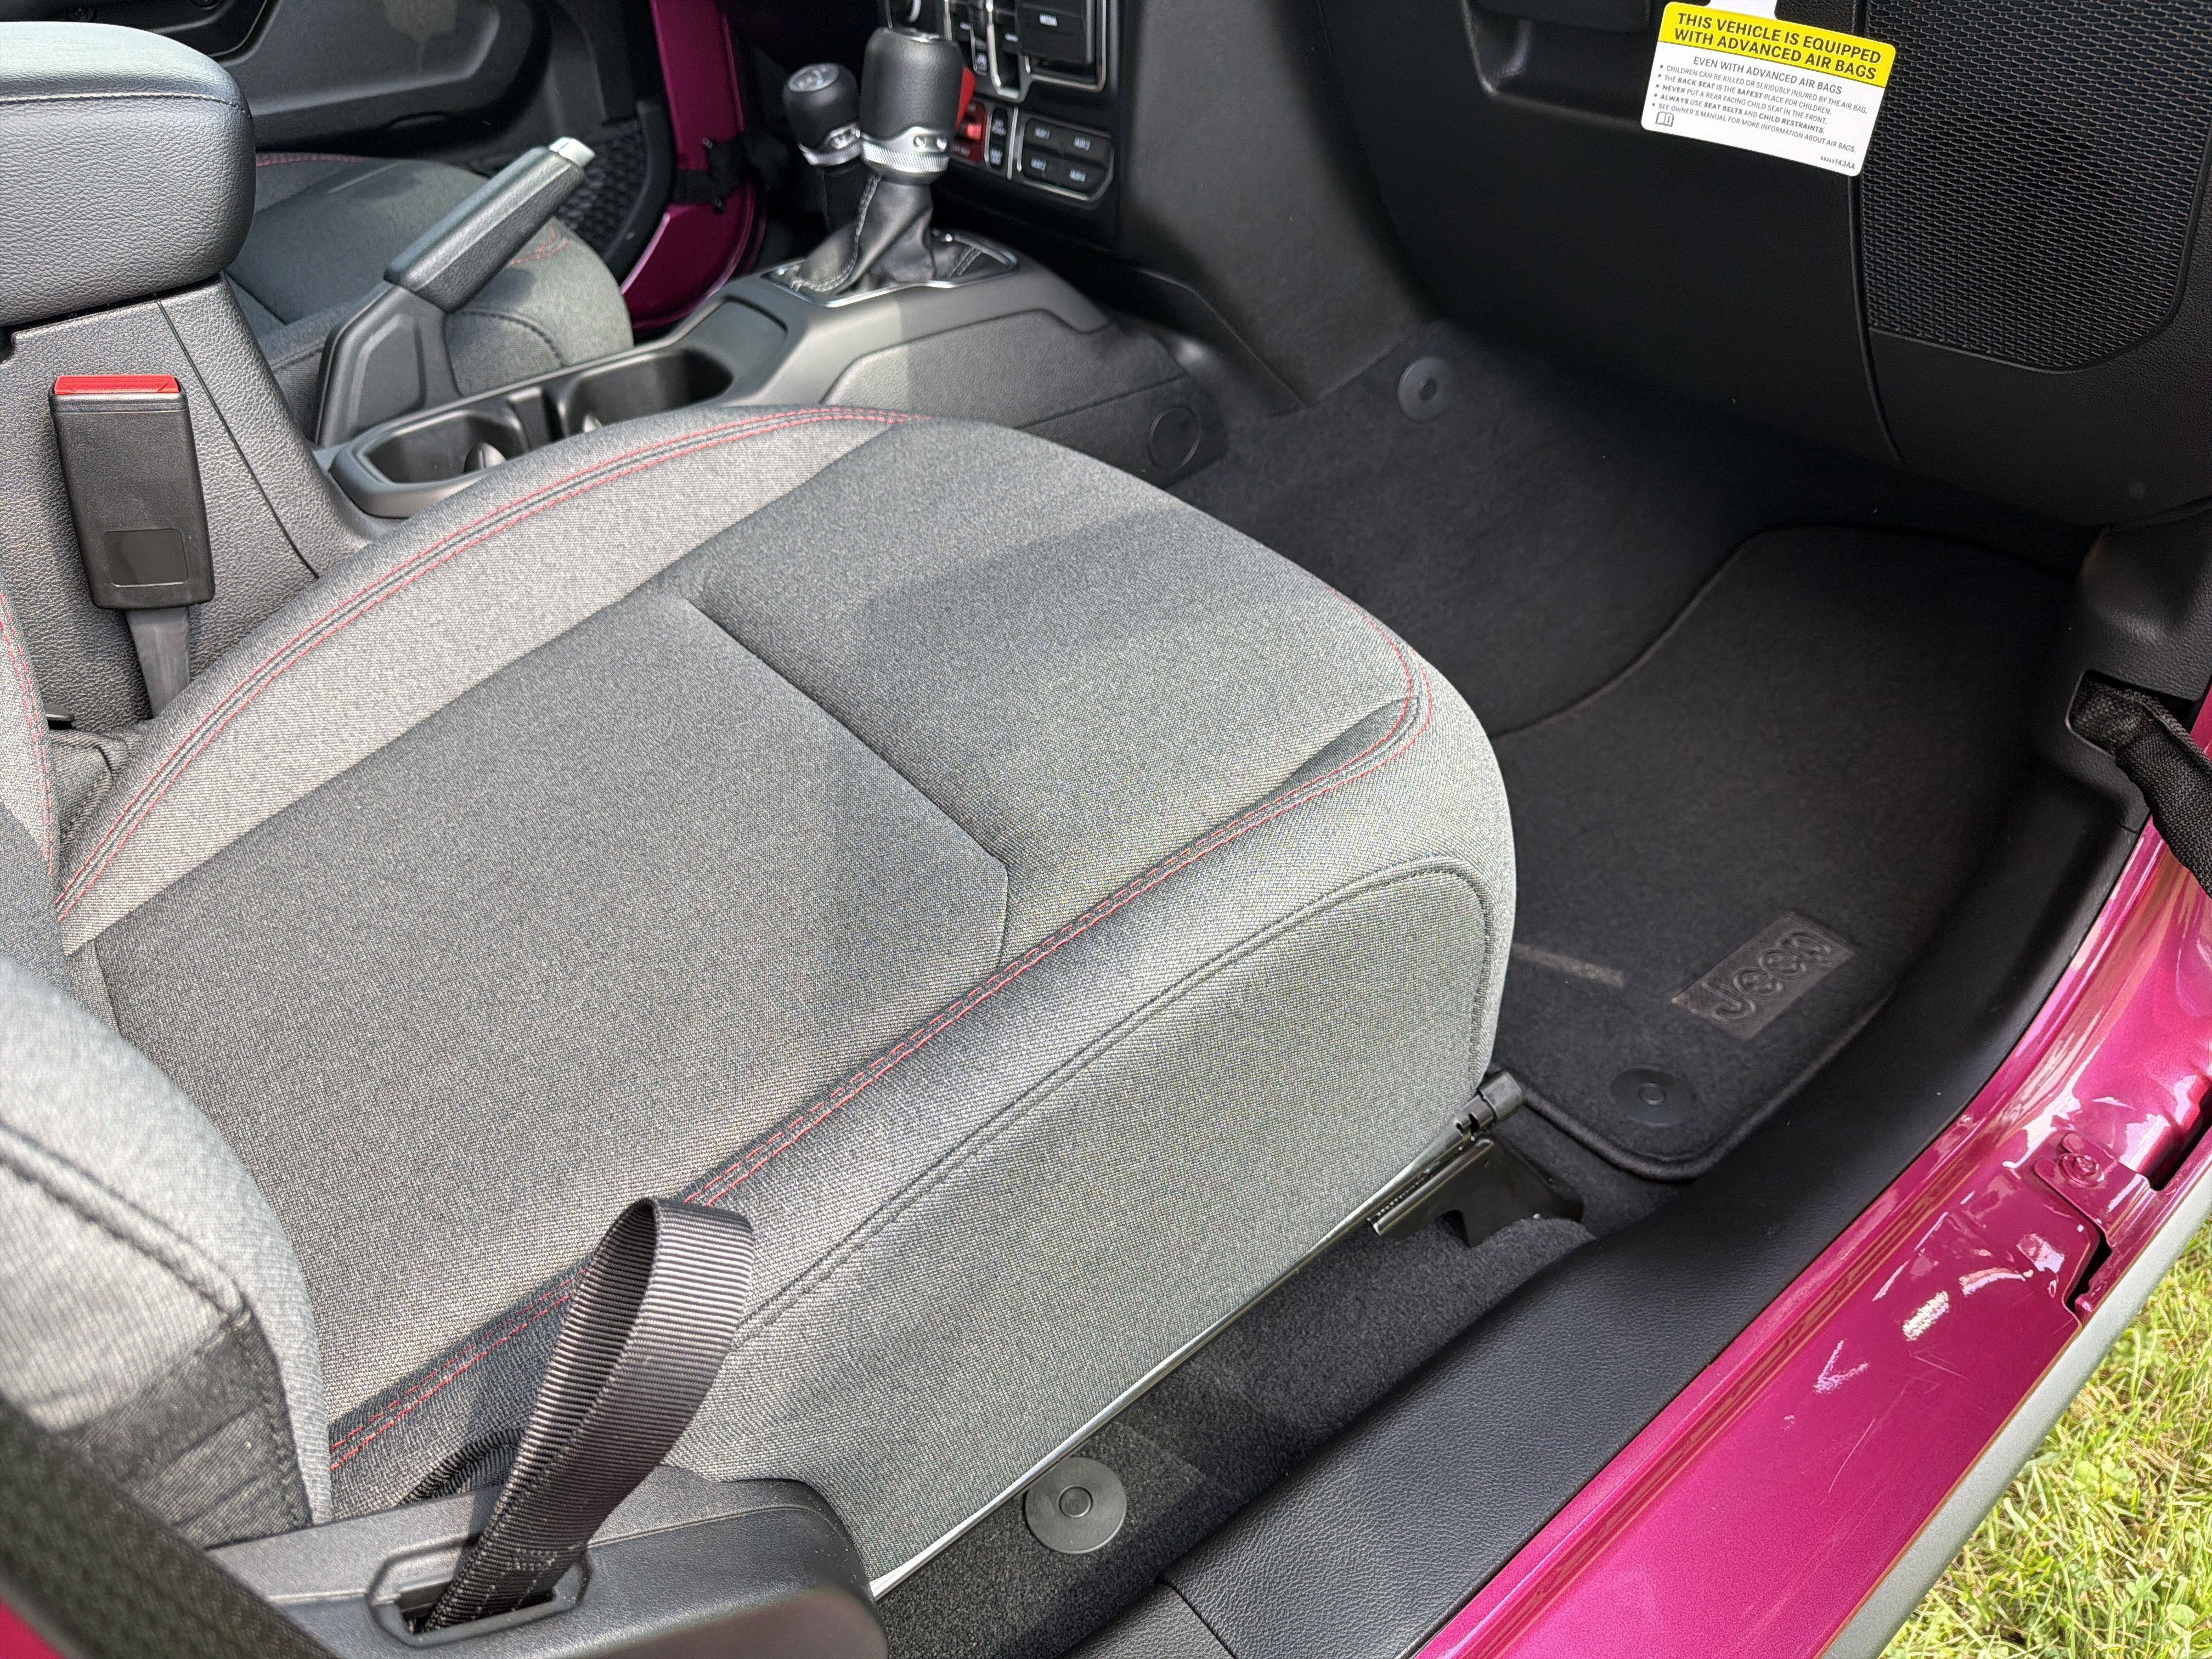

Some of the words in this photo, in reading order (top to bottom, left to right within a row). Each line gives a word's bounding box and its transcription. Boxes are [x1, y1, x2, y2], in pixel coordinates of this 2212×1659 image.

[1675, 28, 1714, 46] WITH
[1716, 36, 1802, 62] ADVANCED
[1804, 53, 1832, 69] AIR
[1835, 59, 1877, 80] BAGS
[1678, 13, 1712, 29] THIS
[1717, 19, 1782, 42] VEHICLE
[1784, 31, 1800, 46] IS
[1803, 35, 1881, 64] EQUIPPED
[1664, 75, 1677, 83] THE
[1677, 77, 1697, 86] BACK
[1697, 81, 1716, 89] SEAT
[1724, 85, 1736, 94] THE
[1736, 88, 1764, 99] SAFEST
[1763, 94, 1784, 104] PLACE
[1785, 98, 1798, 107] FOR
[1798, 101, 1831, 115] CHILDREN.
[1666, 65, 1698, 76] CHILDREN
[1723, 75, 1745, 85] KILLED
[1756, 82, 1791, 94] SERIOUSLY
[1791, 89, 1818, 101] INJURED
[1828, 98, 1841, 107] THE
[1841, 101, 1852, 110] AIR
[1853, 104, 1867, 114] BAG.
[1693, 56, 1718, 69] EVEN
[1720, 61, 1745, 74] WITH
[1745, 66, 1797, 84] ADVANCED
[1798, 77, 1815, 89] AIR
[1816, 81, 1842, 95] BAGS
[1660, 94, 1689, 104] ALWAYS
[1703, 101, 1722, 110] SEAT
[1722, 105, 1743, 115] BELTS
[1743, 110, 1758, 118] AND
[1758, 113, 1780, 123] CHILD
[1781, 118, 1825, 134] RESTRAINTS.
[1662, 84, 1685, 94] NEVER
[1706, 92, 1722, 101] REAR
[1723, 95, 1746, 106] FACING
[1747, 100, 1767, 110] CHILD
[1767, 105, 1783, 114] SEAT
[1792, 110, 1804, 119] THE
[1805, 113, 1827, 125] FRONT.
[1671, 105, 1699, 116] OWNER'S
[1700, 111, 1726, 122] MANUAL
[1741, 119, 1760, 129] MORE
[1760, 123, 1804, 139] INFORMATION
[1804, 134, 1826, 144] ABOUT
[1826, 139, 1837, 148] AIR
[1837, 142, 1855, 153] BAGS.
[1702, 931, 1833, 1023] Jeep
